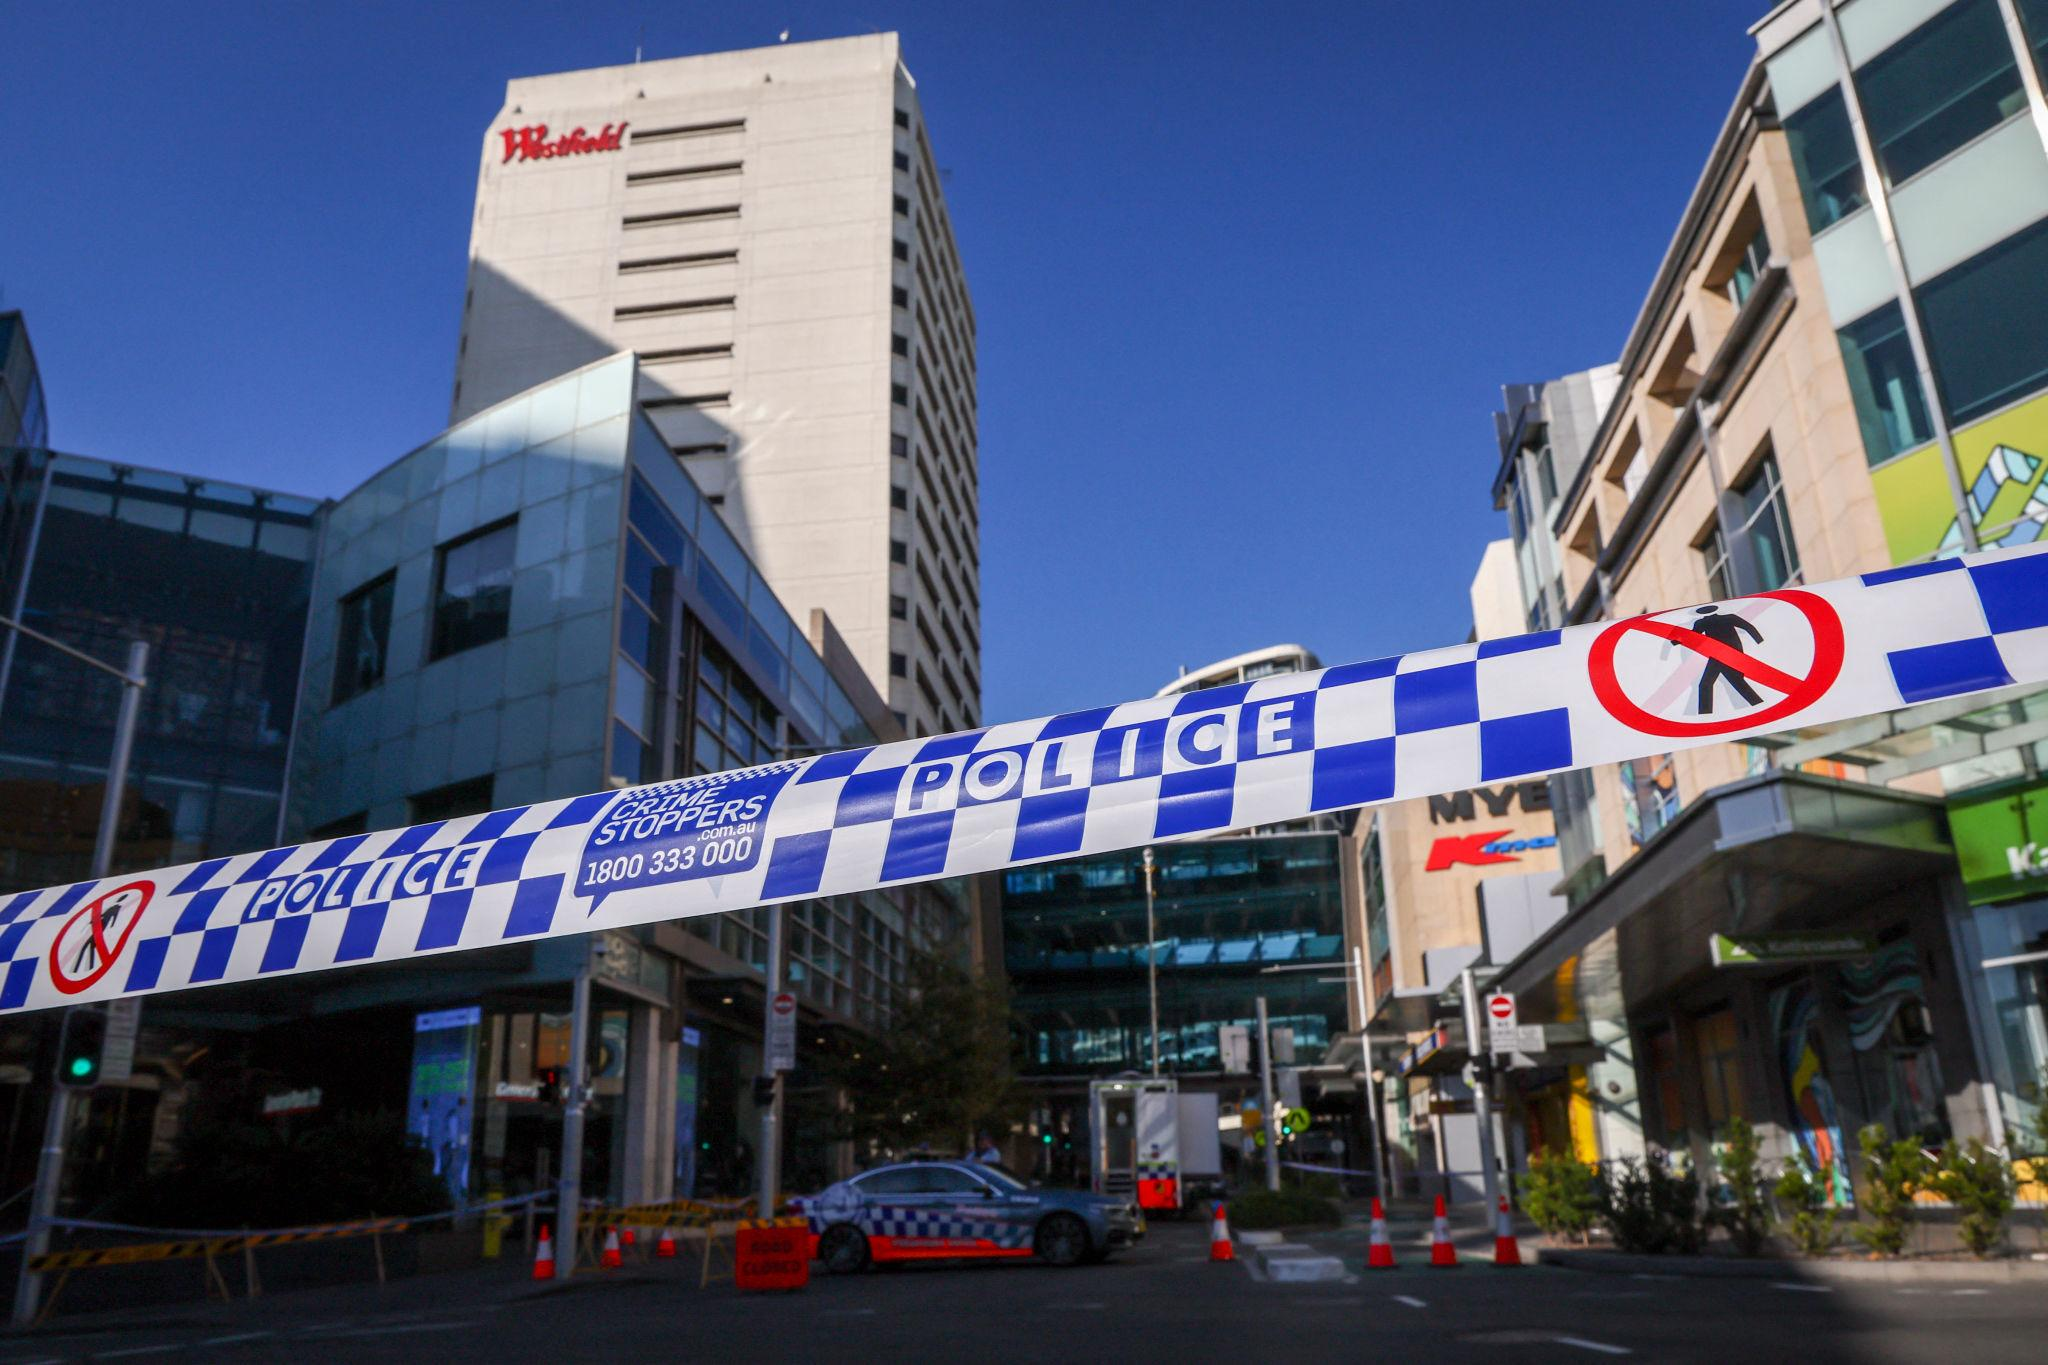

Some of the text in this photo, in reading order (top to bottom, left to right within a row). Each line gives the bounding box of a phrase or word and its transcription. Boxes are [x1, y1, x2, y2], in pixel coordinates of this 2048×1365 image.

[499, 121, 629, 165] Westfield
[907, 700, 1294, 811] POLICE
[595, 795, 767, 845] STOPPERS
[611, 785, 728, 821] CRIME
[697, 821, 756, 842] .com.au
[248, 846, 482, 919] POLICE
[583, 836, 752, 886] 1800 333 000
